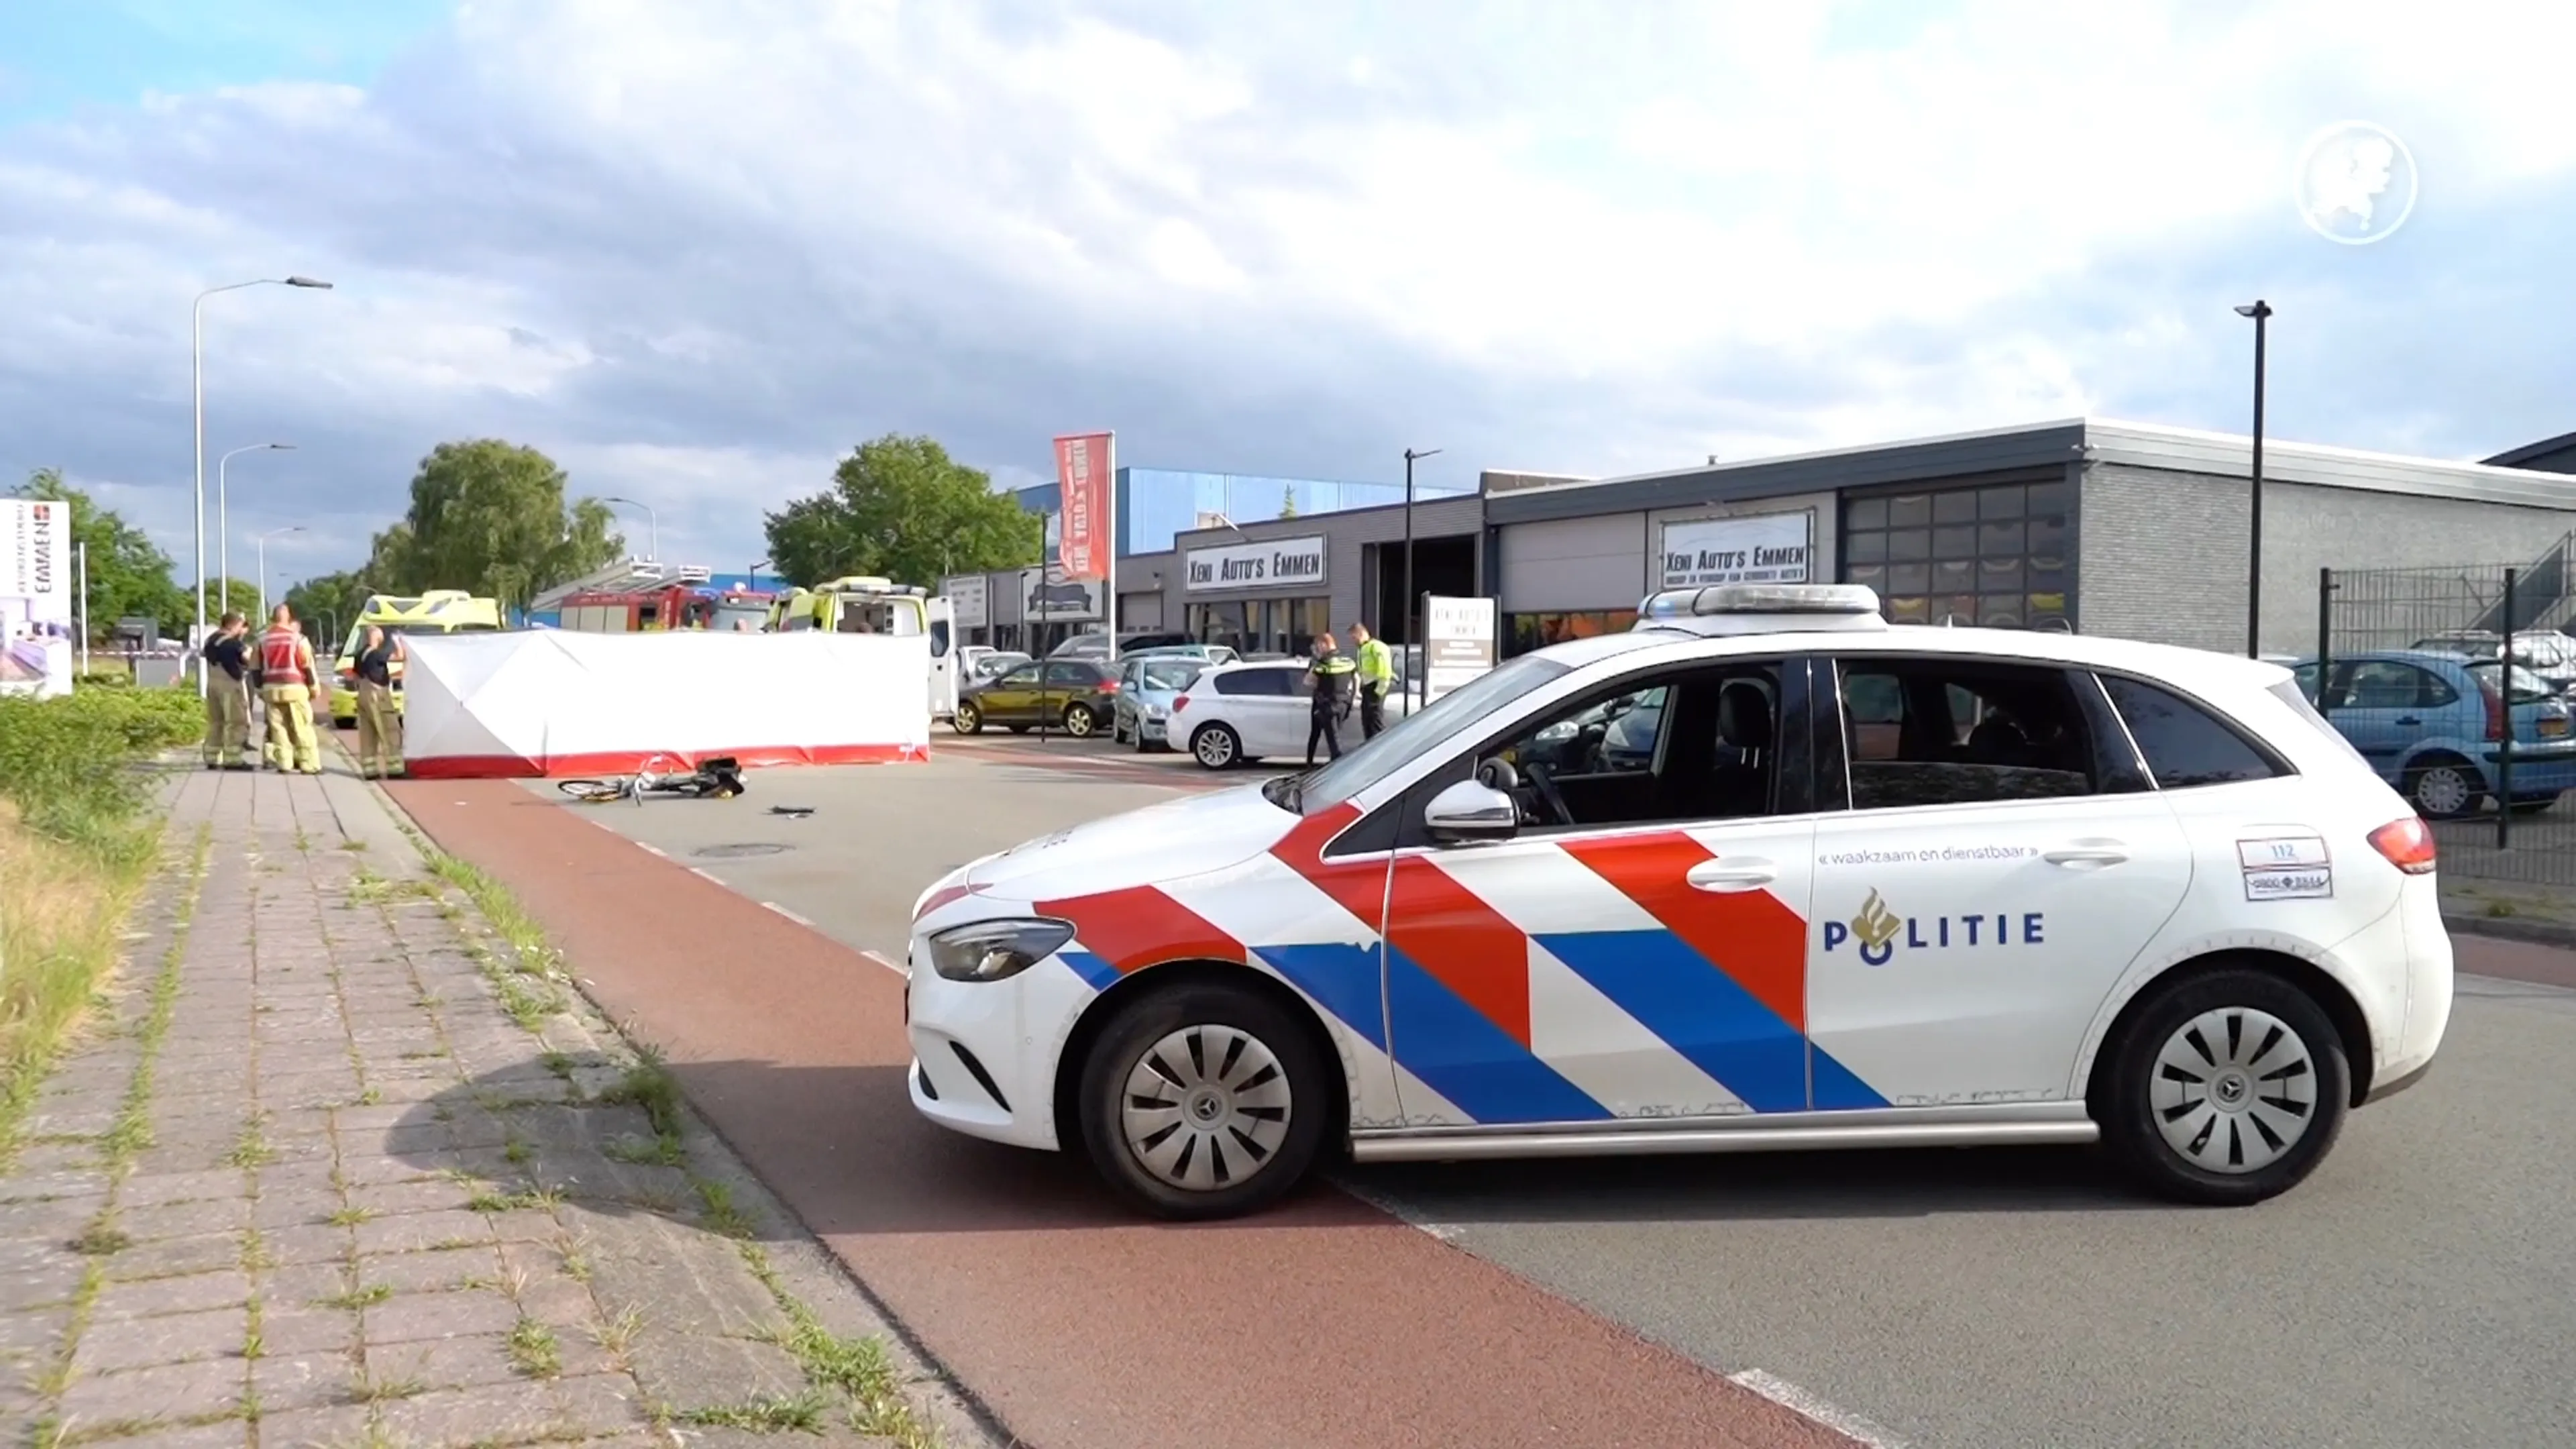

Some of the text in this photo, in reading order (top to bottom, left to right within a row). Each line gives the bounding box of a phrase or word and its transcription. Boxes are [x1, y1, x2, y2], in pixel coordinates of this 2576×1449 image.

[34, 522, 52, 593] EMMEN
[1221, 557, 1265, 582] AUTO'S
[1273, 552, 1320, 577] EMMEN
[1698, 549, 1746, 570] AUTO'S
[1753, 545, 1805, 566] EMMEN
[1831, 849, 1916, 865] waakzaam
[1919, 849, 1939, 861] en
[1942, 845, 2026, 861] dienstbaar
[2271, 843, 2295, 857] 112
[1824, 913, 2044, 966] POLITIE
